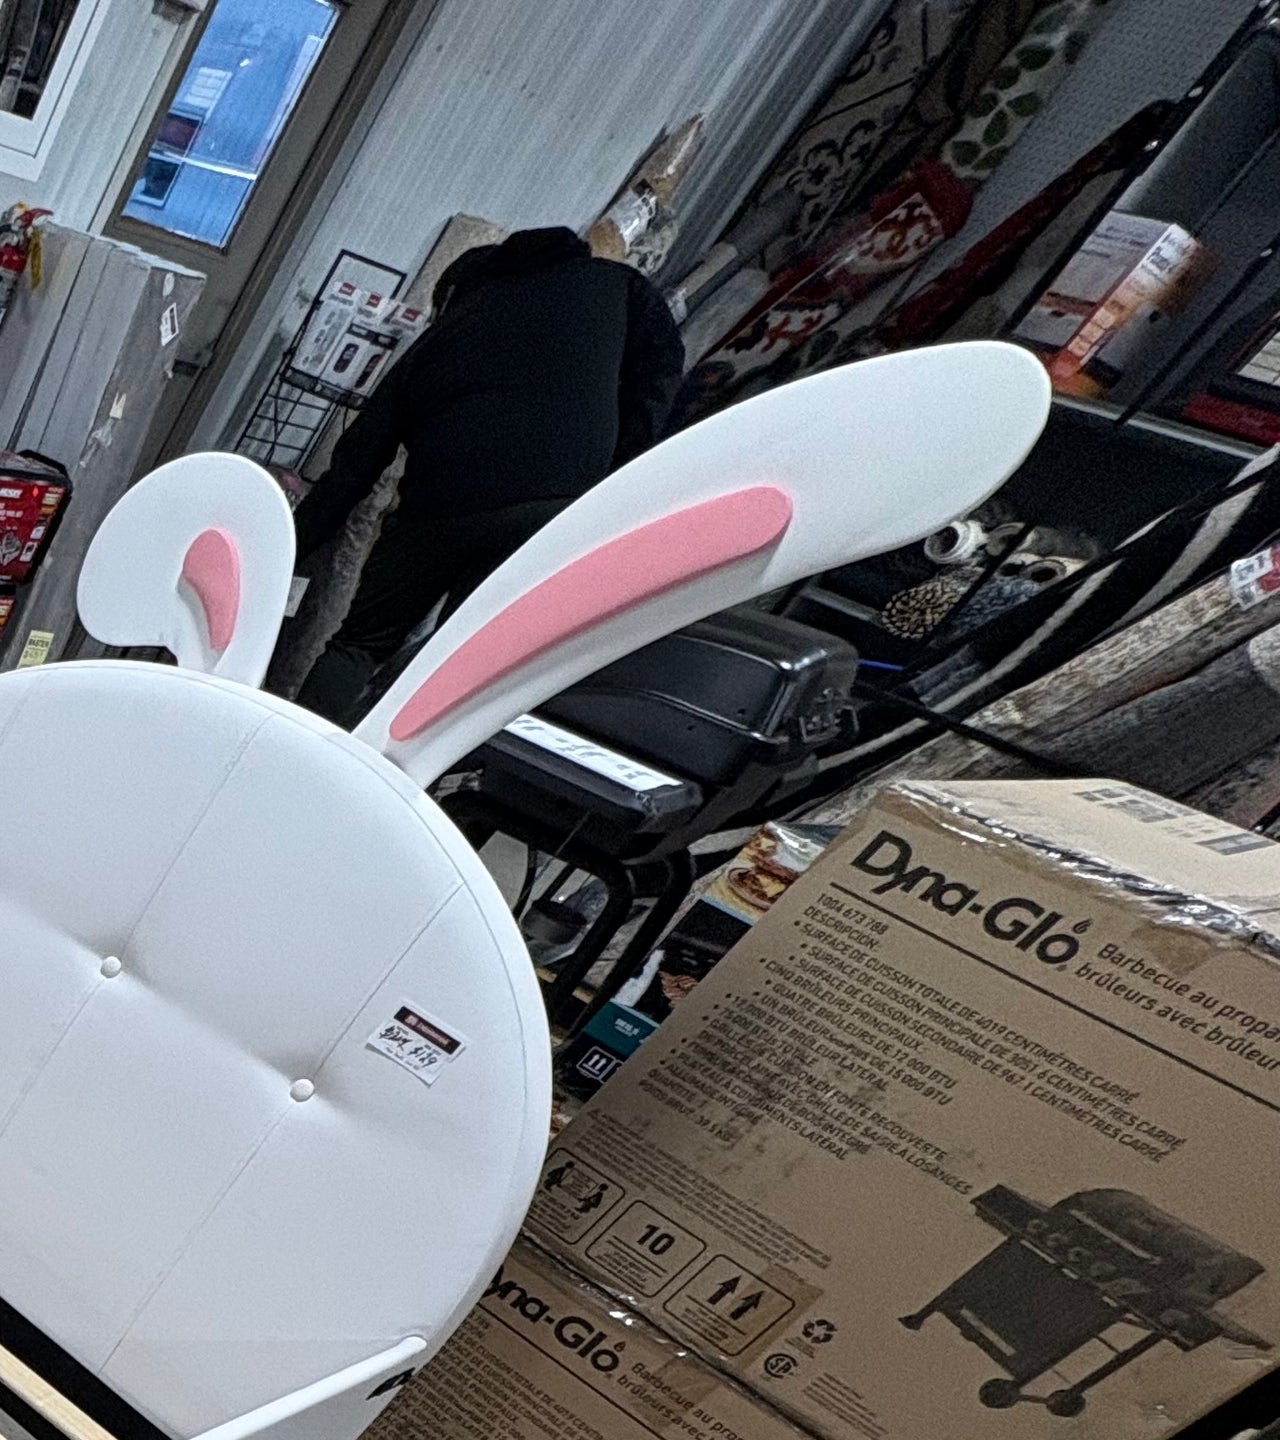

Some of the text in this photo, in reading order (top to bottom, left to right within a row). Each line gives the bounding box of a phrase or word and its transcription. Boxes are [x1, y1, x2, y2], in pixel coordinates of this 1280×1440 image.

[841, 906, 867, 924] 673
[863, 917, 889, 936] 788
[850, 829, 1082, 967] Dyna-Glo
[764, 960, 795, 981] CINQ
[799, 922, 853, 955] SURFACE
[847, 947, 868, 963] DE
[863, 956, 921, 991] CUISSON
[913, 982, 959, 1011] TOTALE
[956, 1005, 979, 1021] DE
[973, 1014, 1007, 1037] 4019
[807, 946, 860, 978] SURFACE
[855, 971, 876, 986] DE
[871, 979, 926, 1013] CUISSON
[921, 1006, 993, 1049] PRINCIPALE
[988, 1041, 1011, 1058] DE
[1074, 962, 1159, 1012] brûleurs
[1157, 1004, 1208, 1035] avec
[1096, 942, 1191, 998] Barbecue
[1190, 991, 1219, 1010] au
[759, 994, 780, 1010] UN
[868, 1055, 889, 1071] DE
[886, 1065, 904, 1080] 15
[899, 1072, 926, 1092] 000
[922, 1085, 953, 1107] BTU
[763, 1015, 789, 1034] BTU
[770, 982, 818, 1013] QUATRE
[872, 1039, 894, 1055] DE
[890, 1048, 908, 1063] 12
[905, 1056, 931, 1076] 000
[927, 1069, 958, 1091] BTU
[795, 957, 849, 990] SURFACE
[843, 982, 864, 998] DE
[859, 991, 915, 1026] CUISSON
[908, 1017, 985, 1064] SECONDAIRE
[980, 1057, 1003, 1074] DE
[813, 1079, 833, 1095] EN
[830, 1089, 872, 1117] FONTE
[867, 1111, 948, 1162] RECOUVERTE
[842, 1114, 863, 1131] DE
[633, 1222, 676, 1259] 10
[486, 1264, 622, 1374] yna-Glo
[615, 1373, 675, 1420] brûleurs
[629, 1361, 695, 1412] Barbecue
[690, 1404, 714, 1425] au
